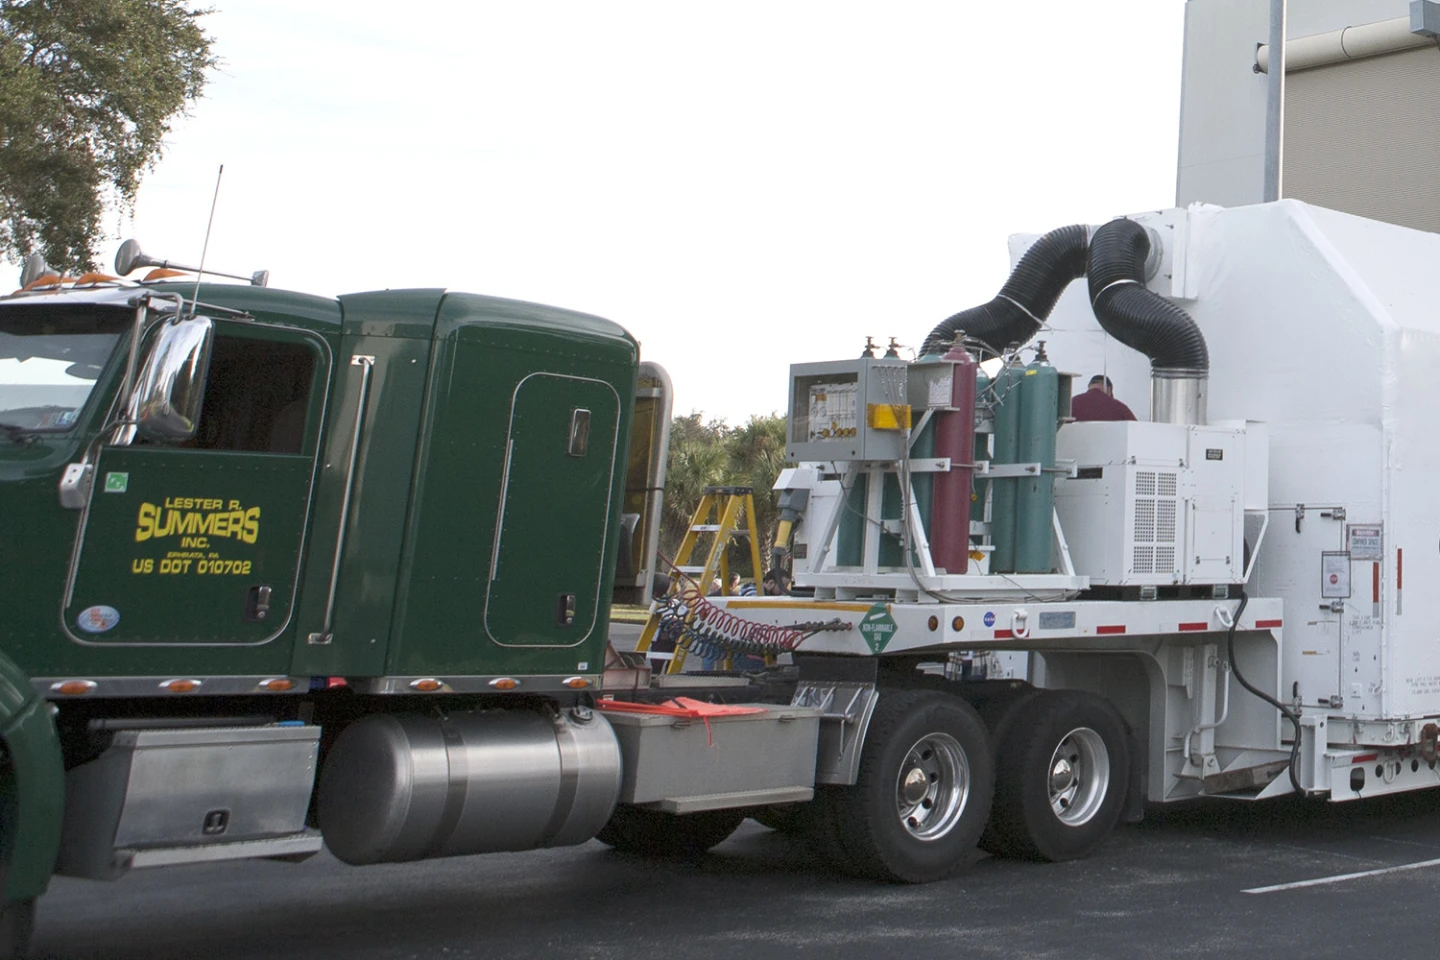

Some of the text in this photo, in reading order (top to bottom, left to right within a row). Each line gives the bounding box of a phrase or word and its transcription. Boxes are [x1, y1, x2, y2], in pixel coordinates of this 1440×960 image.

[165, 497, 242, 511] LESTER R.
[135, 502, 261, 544] SUMMERS
[181, 537, 210, 548] INC.
[166, 551, 206, 559] EPHRATA,
[132, 559, 252, 575] US DOT 010702
[862, 624, 894, 633] NON-FLAMMABLE
[874, 642, 880, 651] 2
